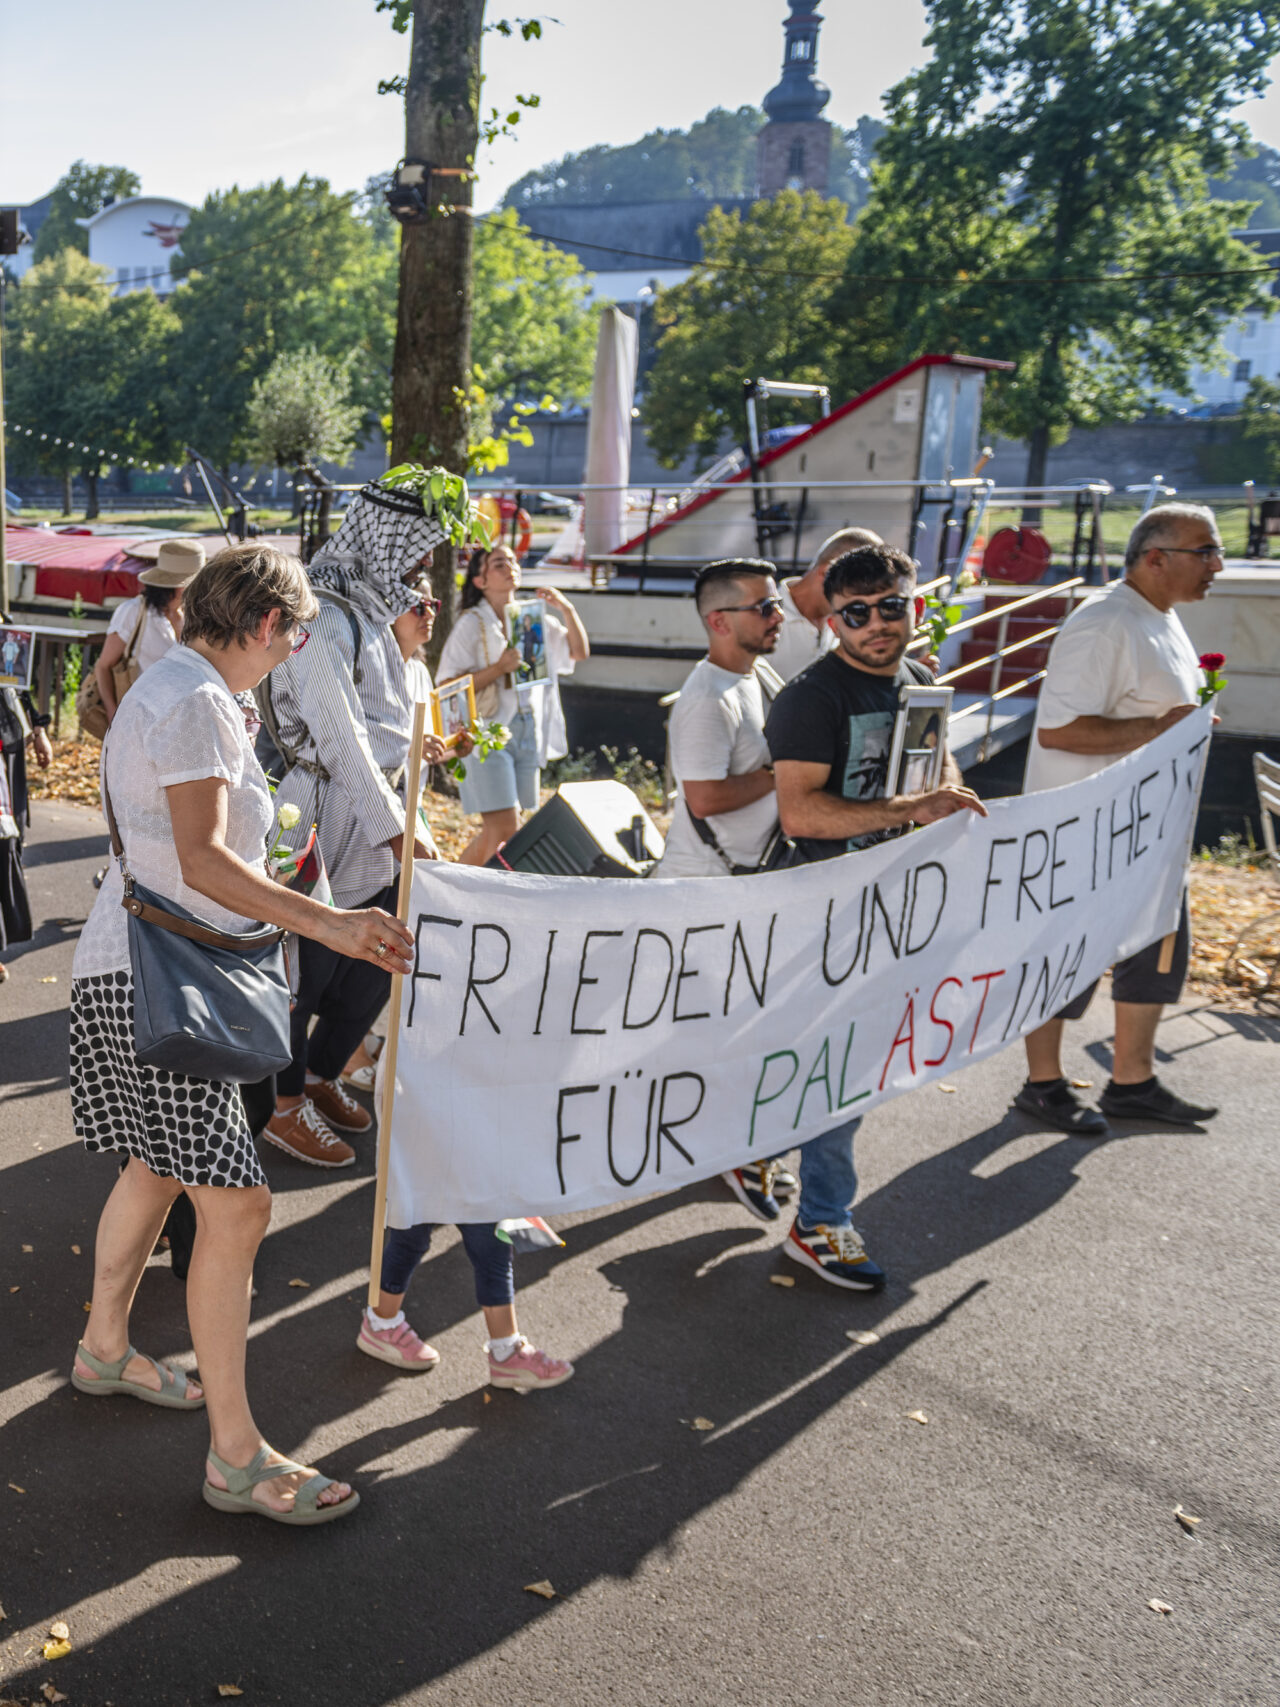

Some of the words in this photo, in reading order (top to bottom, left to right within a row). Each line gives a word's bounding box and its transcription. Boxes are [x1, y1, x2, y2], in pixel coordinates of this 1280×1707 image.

[407, 912, 778, 1037] FRIEDEN
[822, 861, 948, 987] UND
[556, 1068, 706, 1196] FÜR
[748, 933, 1088, 1148] PALÄSTINA
